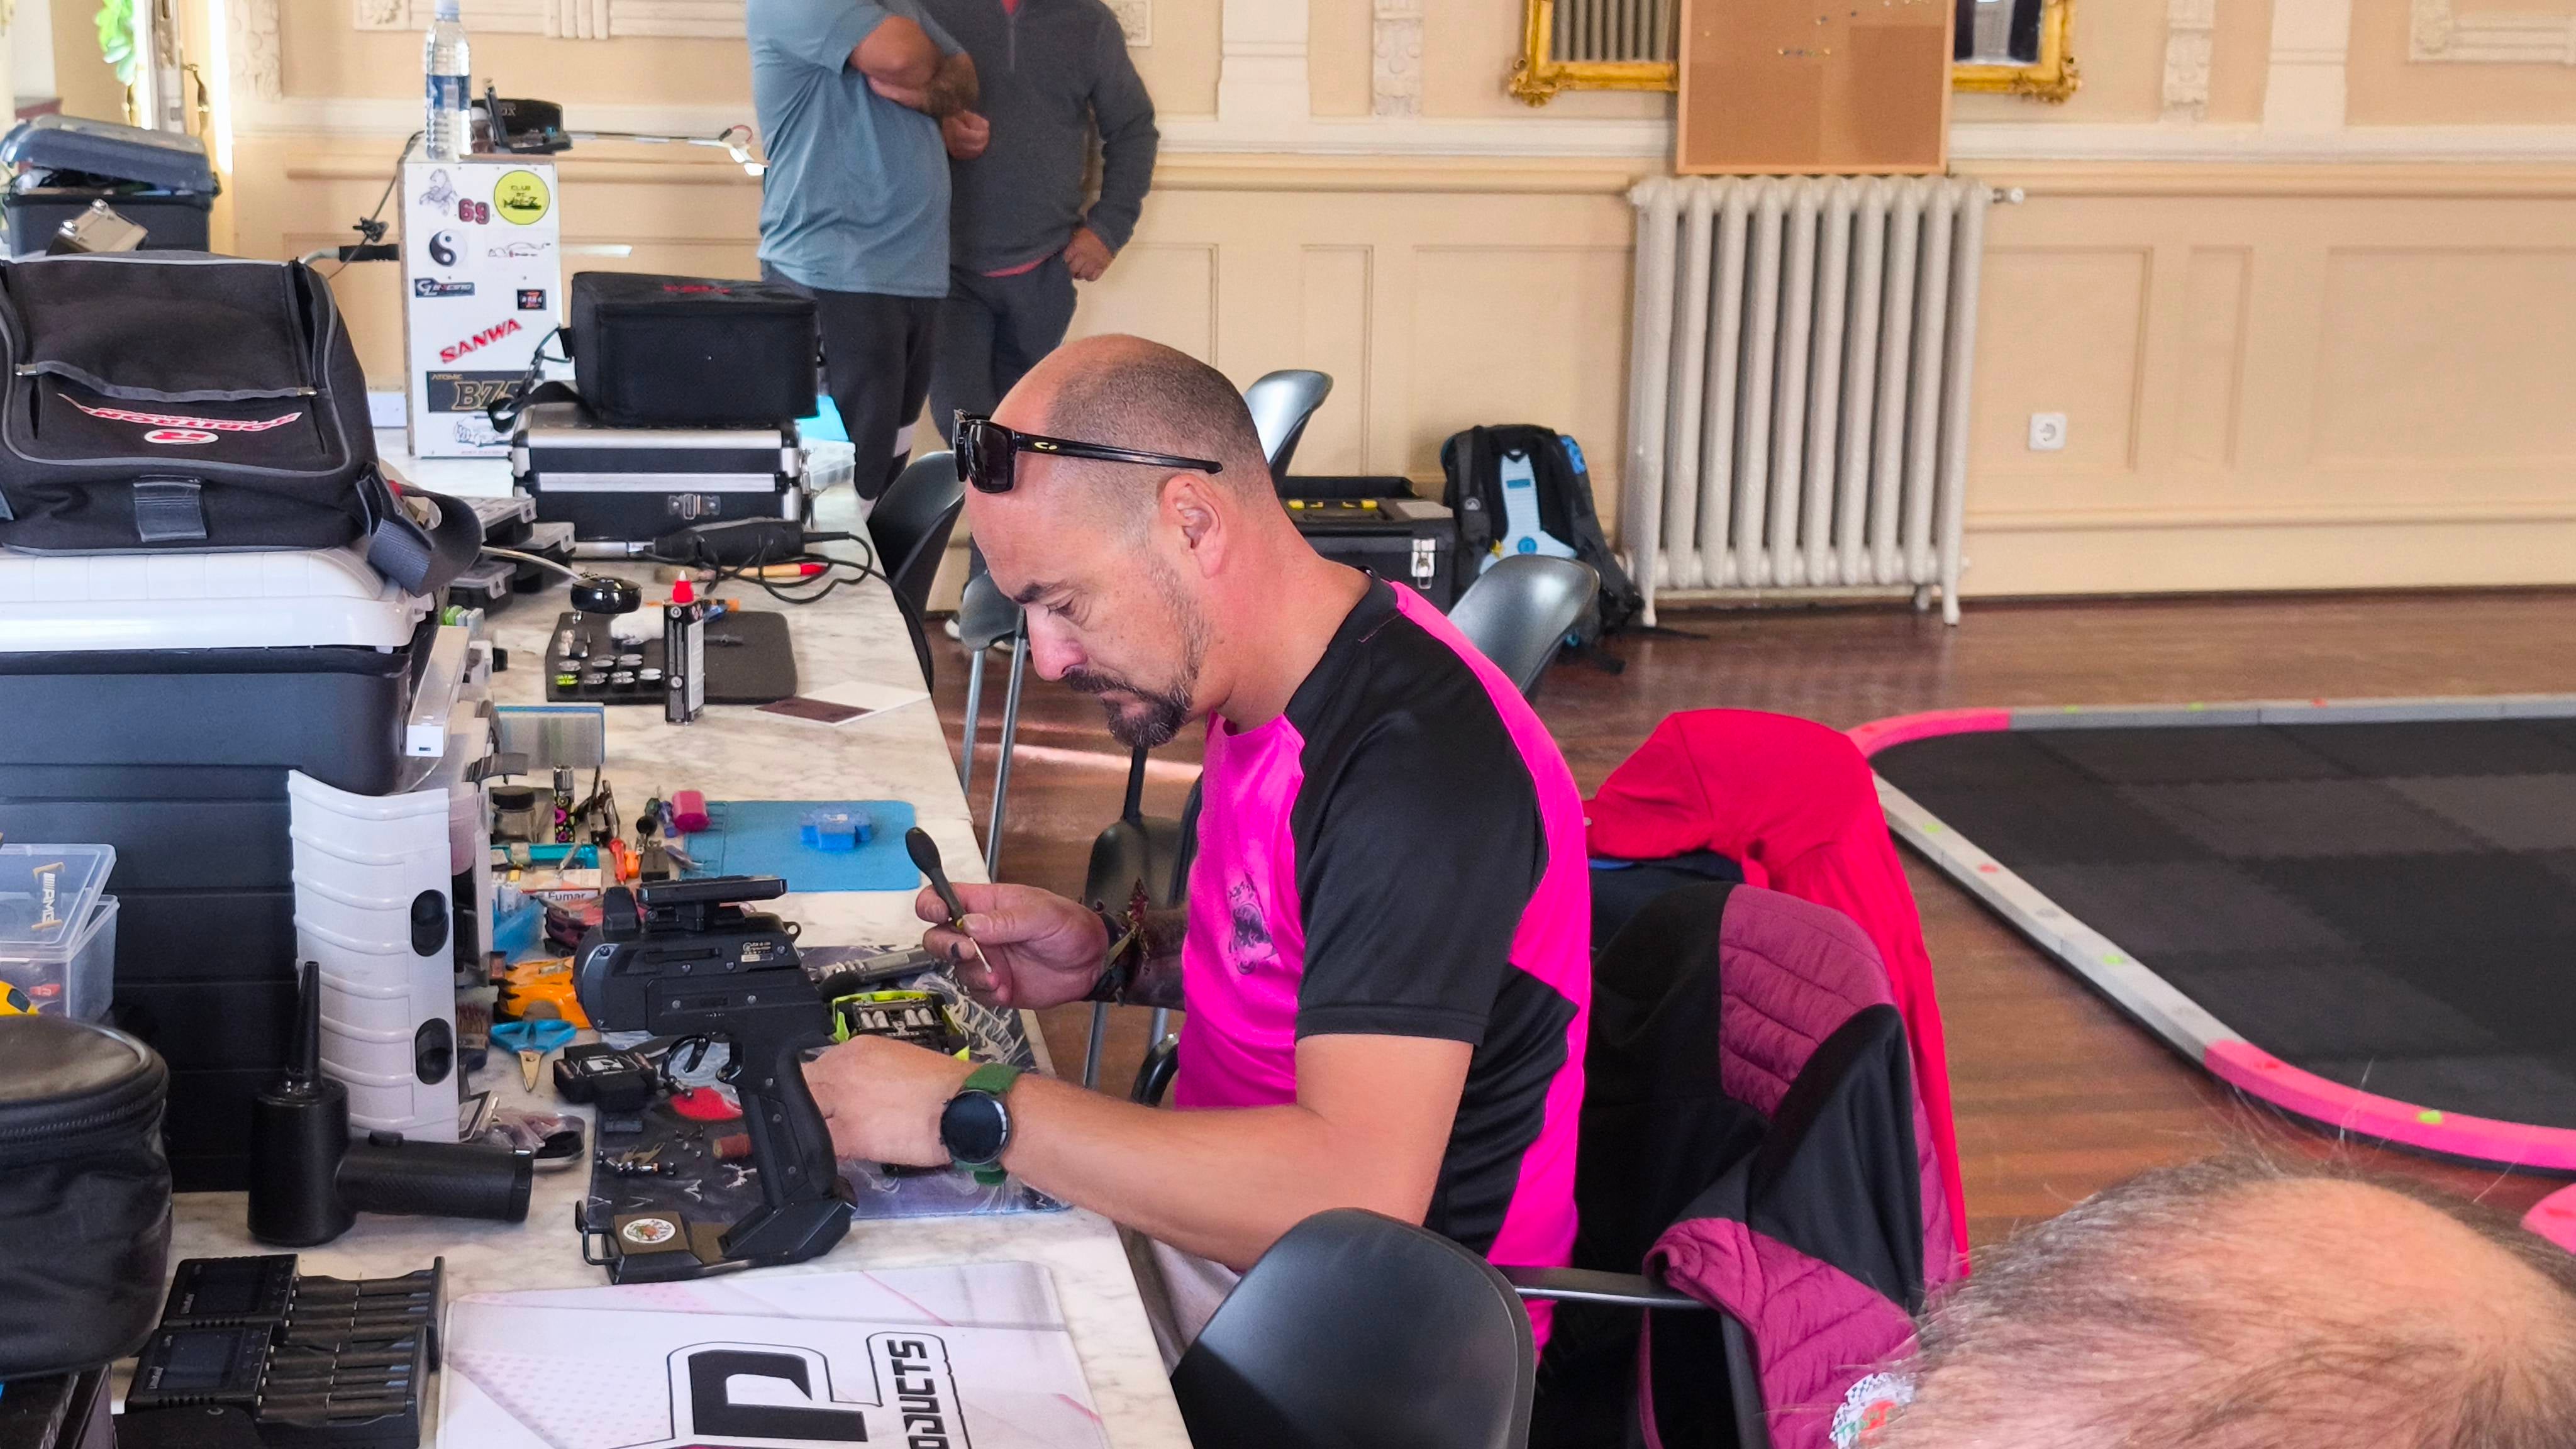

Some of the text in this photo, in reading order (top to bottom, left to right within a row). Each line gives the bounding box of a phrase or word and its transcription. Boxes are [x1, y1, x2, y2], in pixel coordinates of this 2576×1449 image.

[458, 198, 490, 225] 69
[440, 318, 522, 364] SANWA
[548, 892, 586, 901] Fumar
